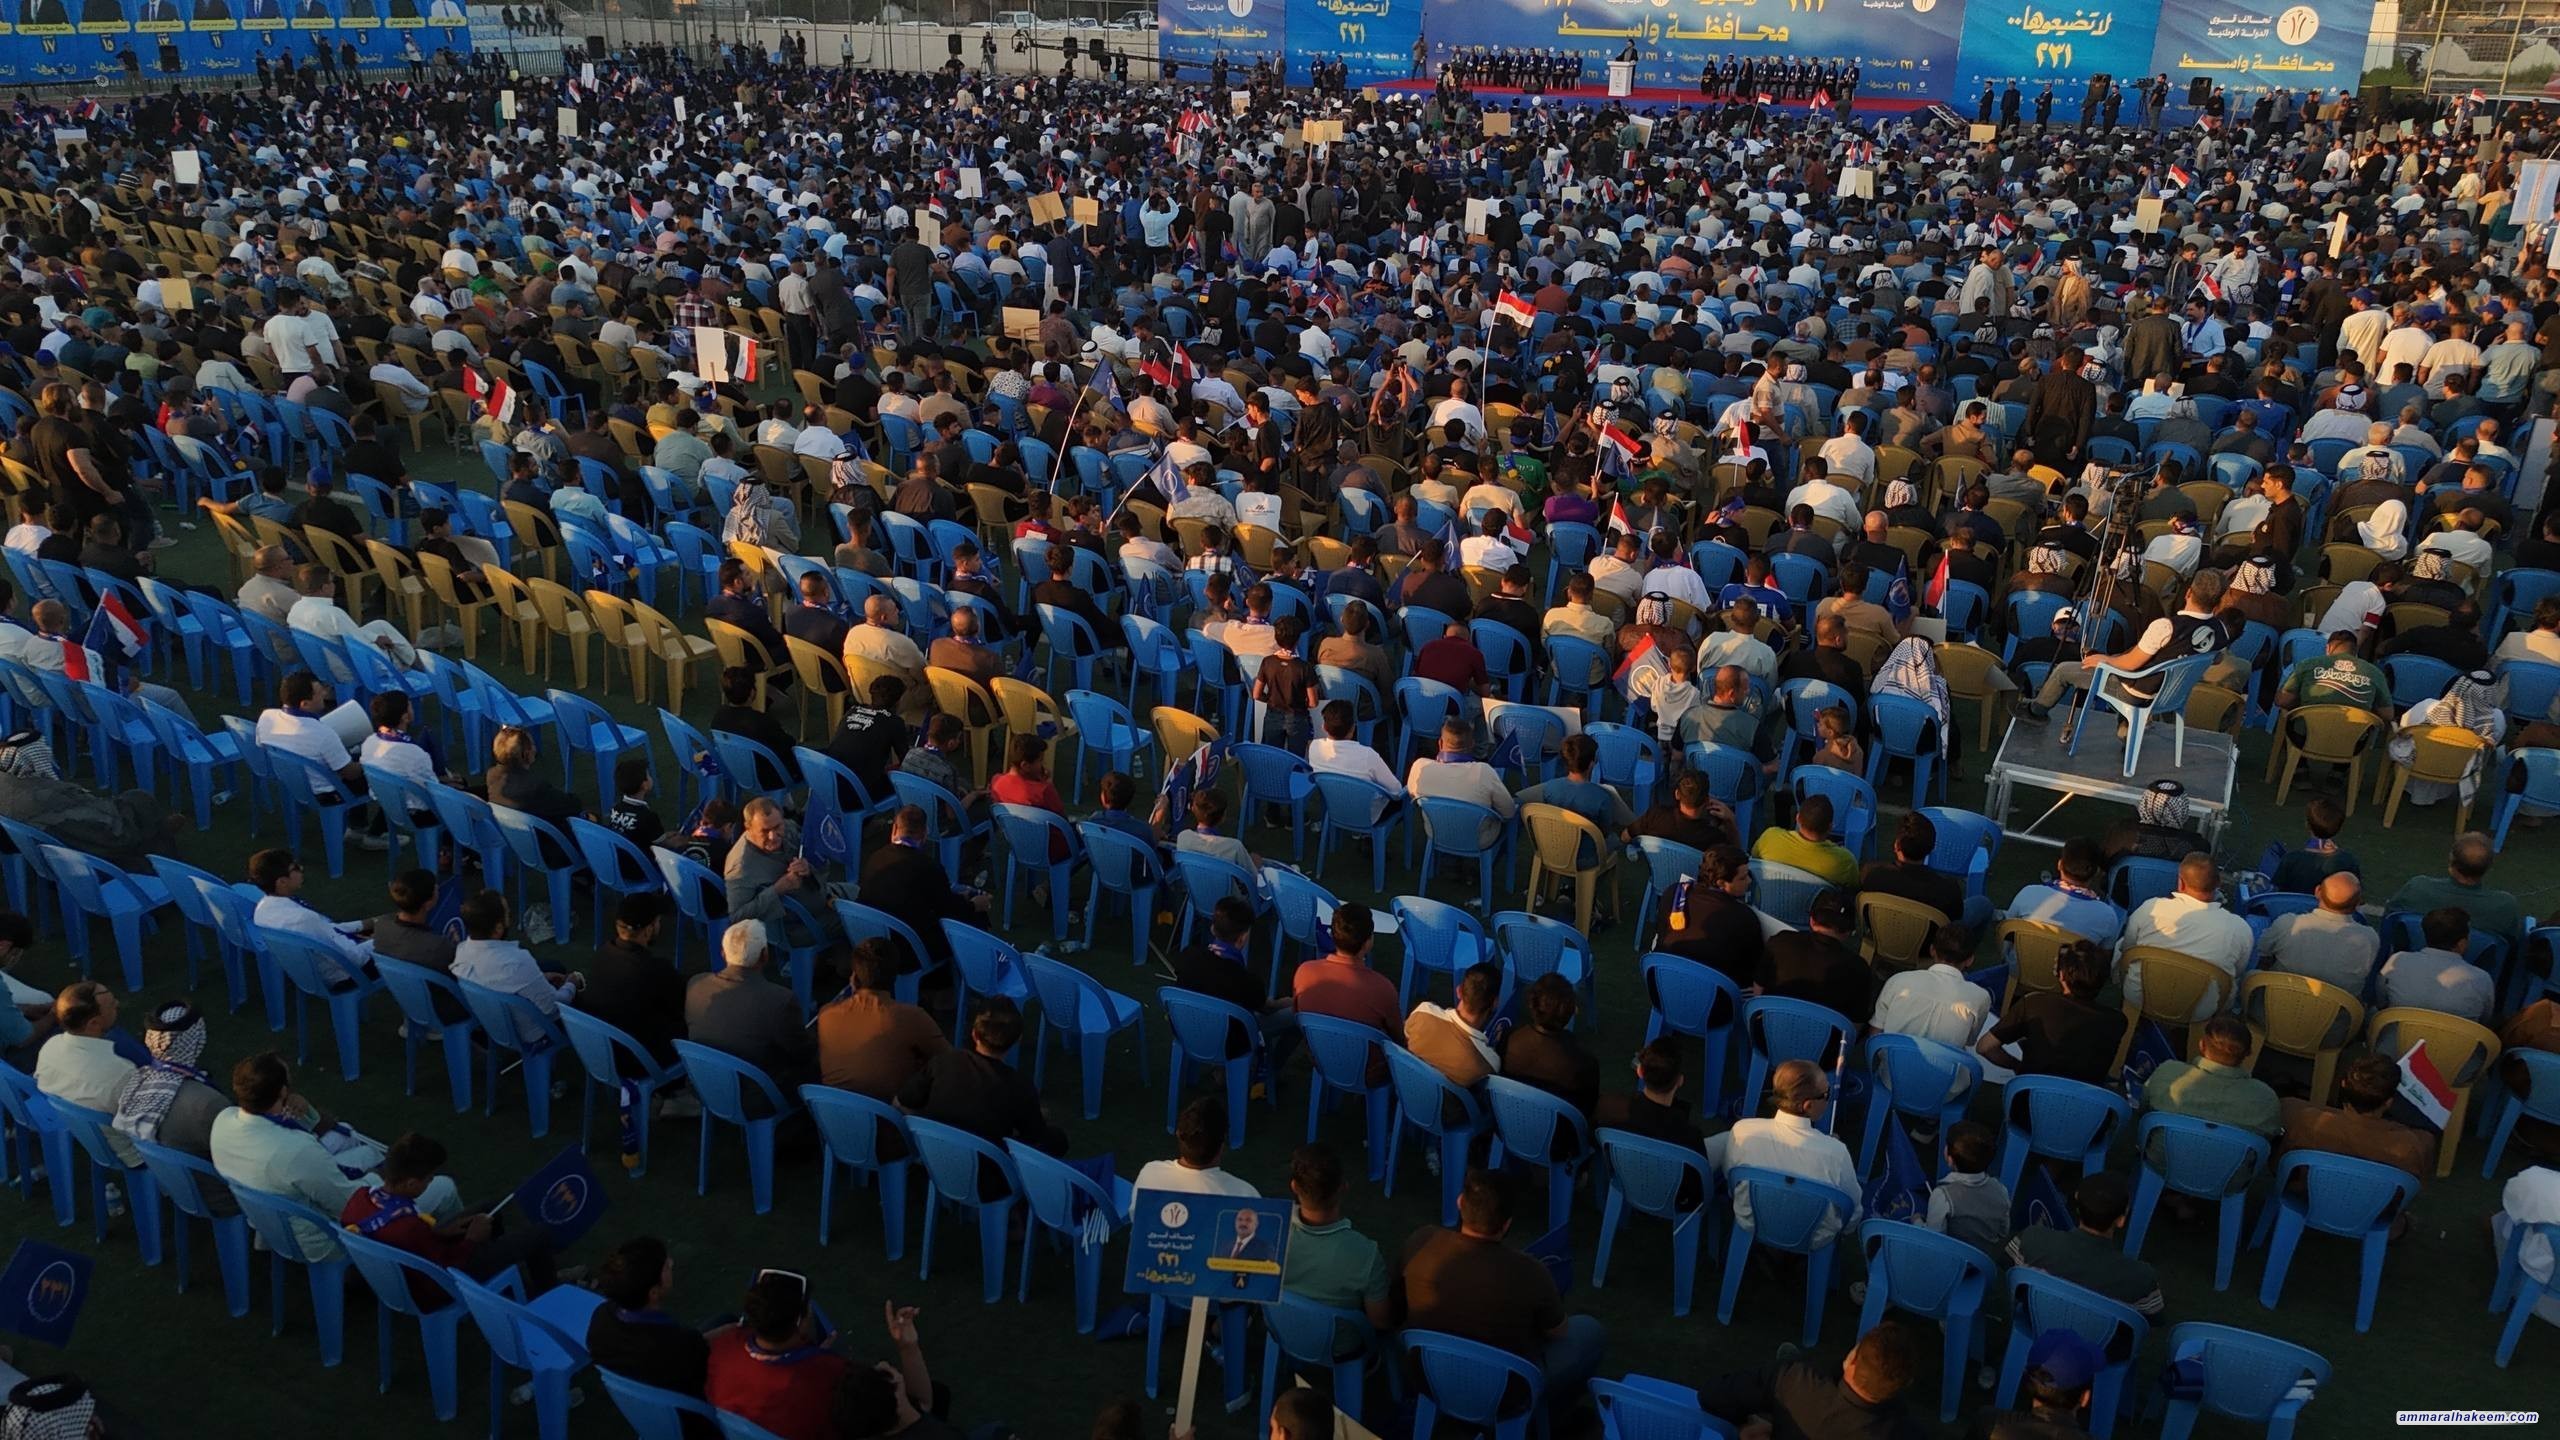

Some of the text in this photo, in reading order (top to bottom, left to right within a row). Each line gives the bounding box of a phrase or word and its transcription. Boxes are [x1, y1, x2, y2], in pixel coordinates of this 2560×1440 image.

[1173, 24, 1268, 39] محافظة واسط
[1339, 22, 1365, 44] ٢٣١
[1558, 11, 1789, 45] محافظة واسط
[42, 39, 56, 54] ١٧
[2036, 42, 2072, 69] ٢٣١
[2178, 52, 2335, 73] محافظة واسط
[1236, 1276, 1245, 1289] ٨
